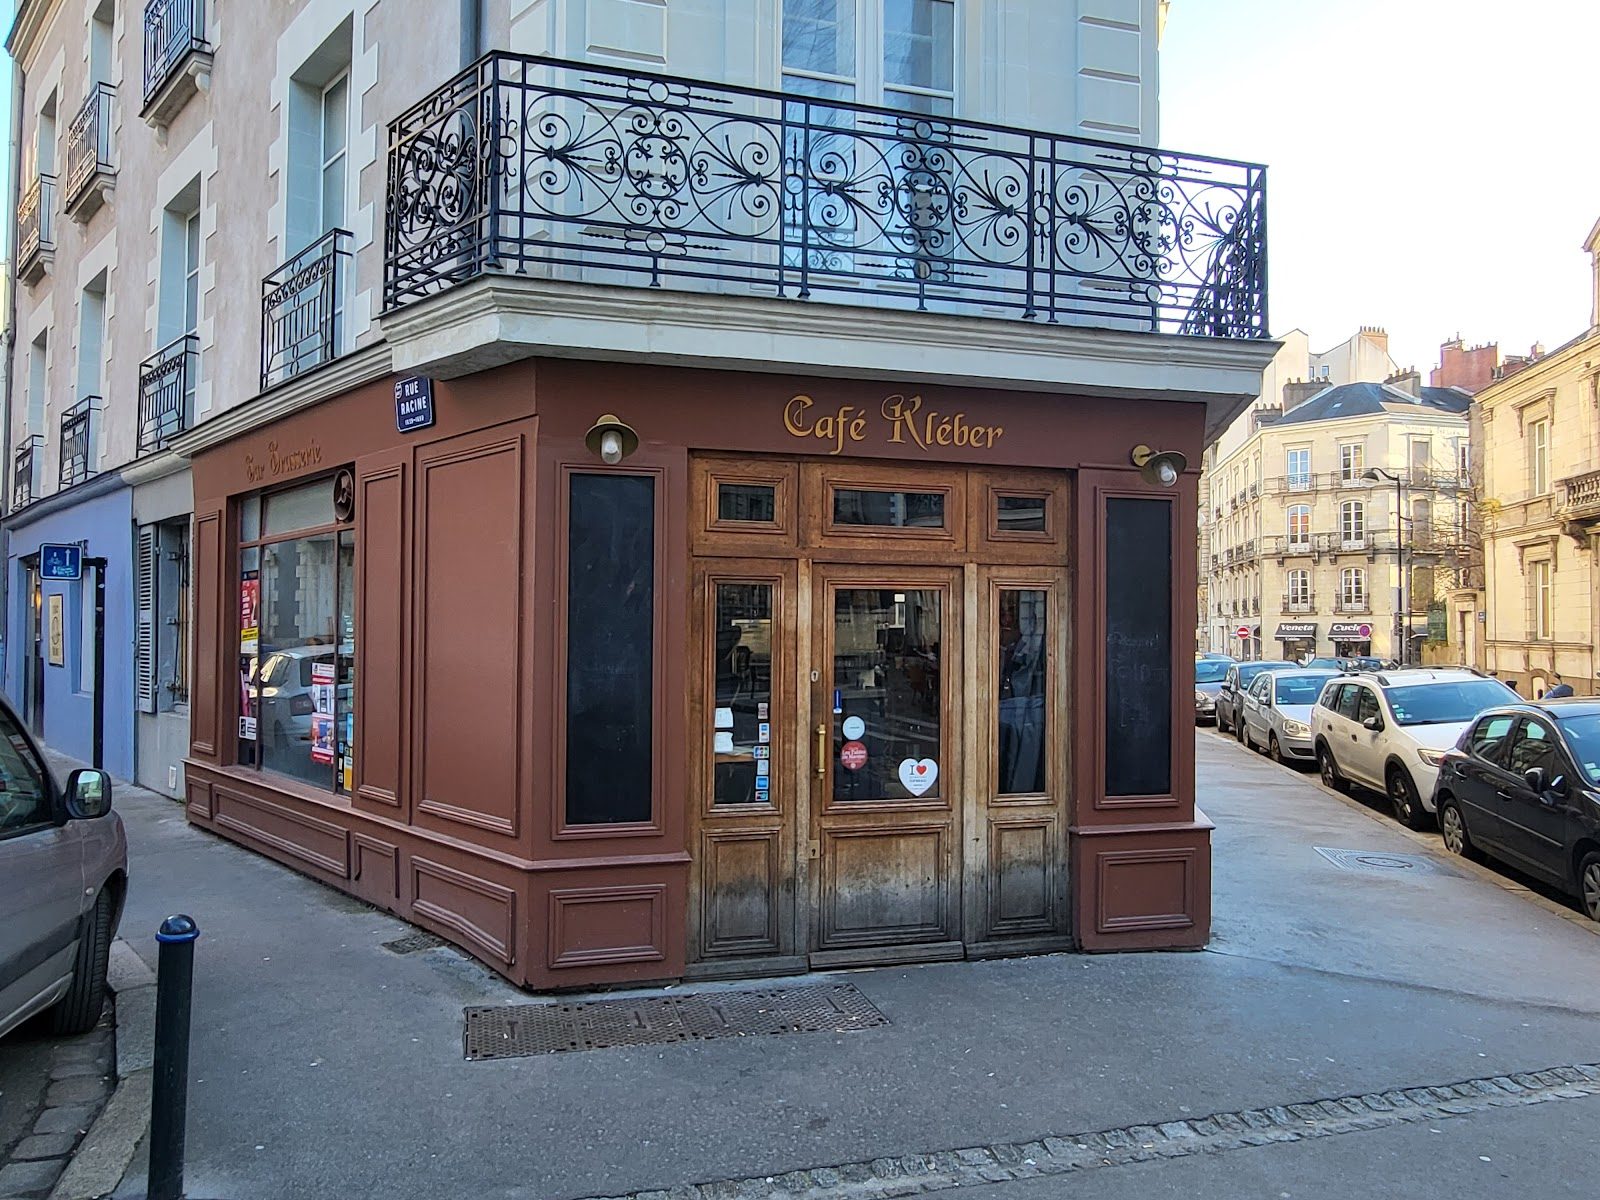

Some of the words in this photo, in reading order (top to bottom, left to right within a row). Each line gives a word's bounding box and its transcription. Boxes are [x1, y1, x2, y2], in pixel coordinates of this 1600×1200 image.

[404, 381, 419, 397] RUE
[400, 395, 427, 415] RACINE
[783, 395, 867, 455] Café
[881, 394, 1003, 452] Kléber
